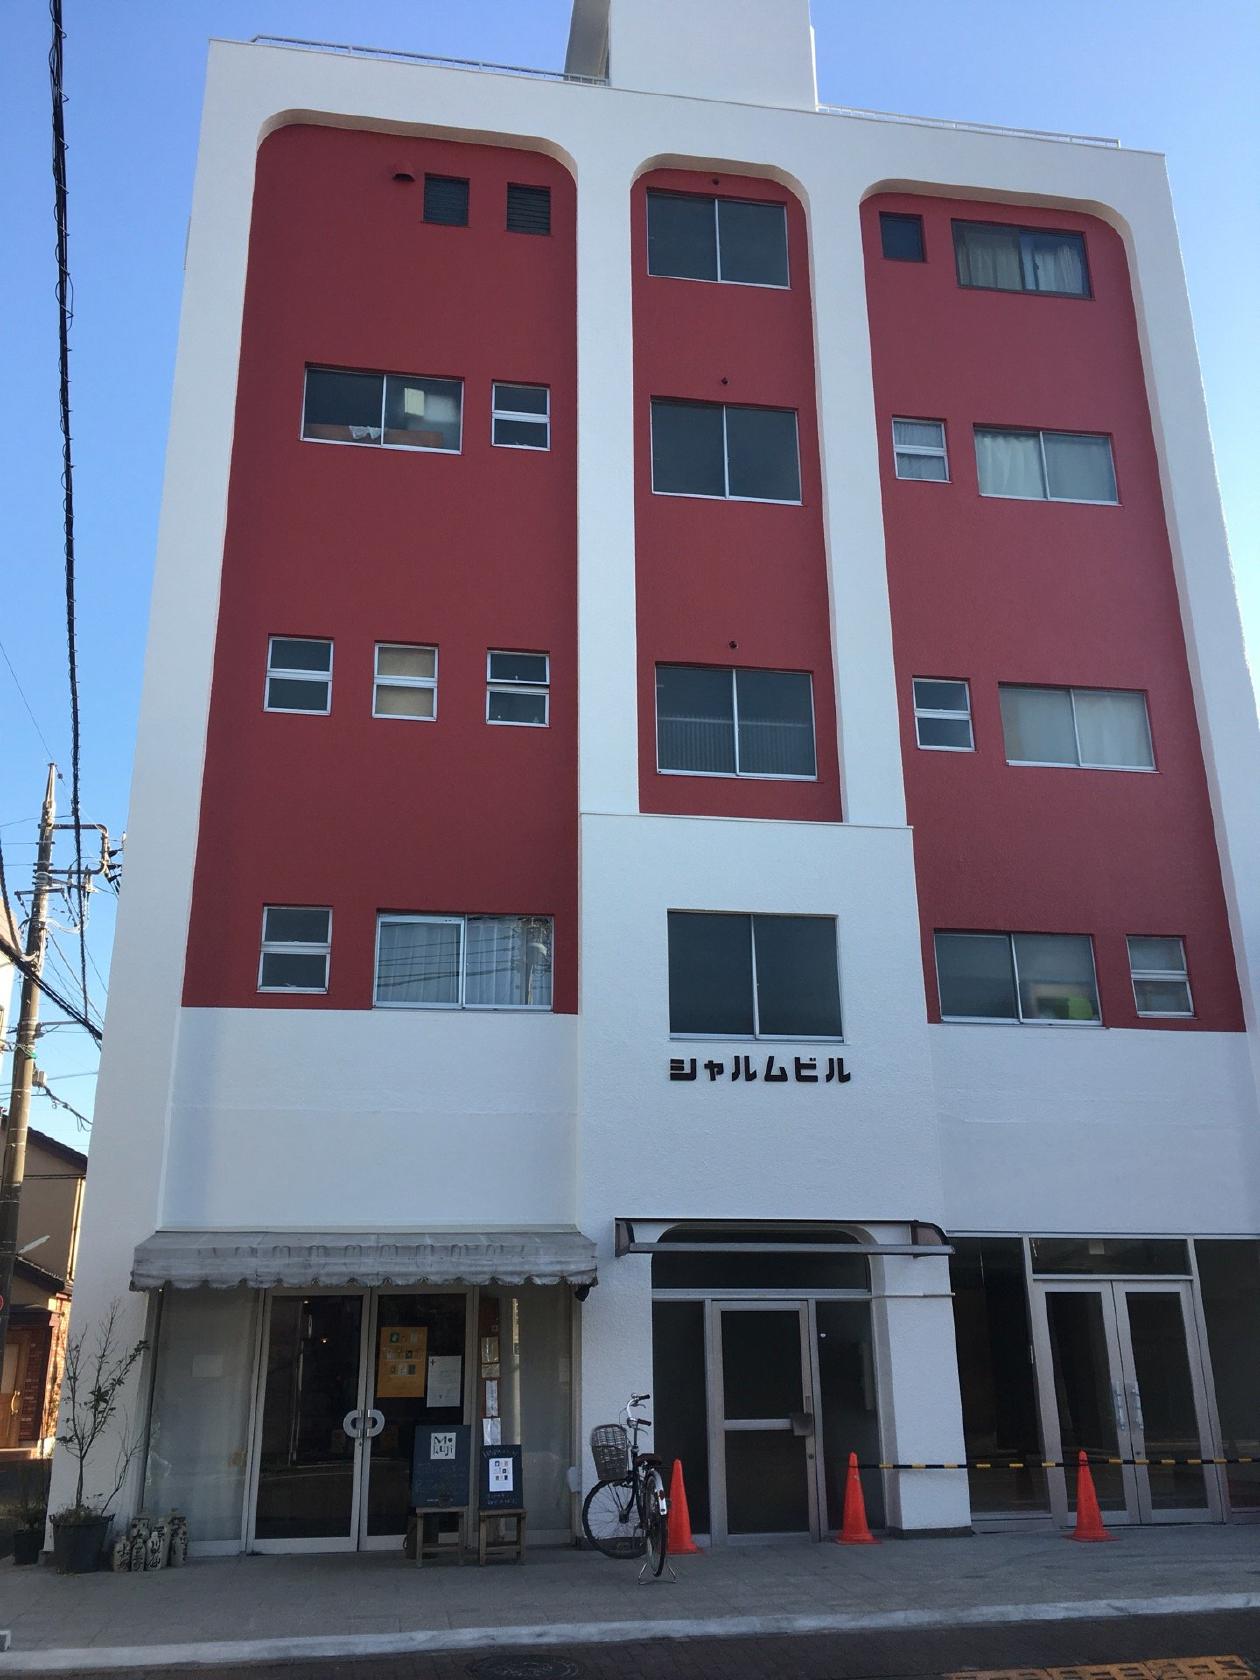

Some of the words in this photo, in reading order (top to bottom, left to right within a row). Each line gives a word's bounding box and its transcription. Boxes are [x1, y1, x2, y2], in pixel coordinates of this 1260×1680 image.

[670, 1056, 850, 1082] シャルムビル
